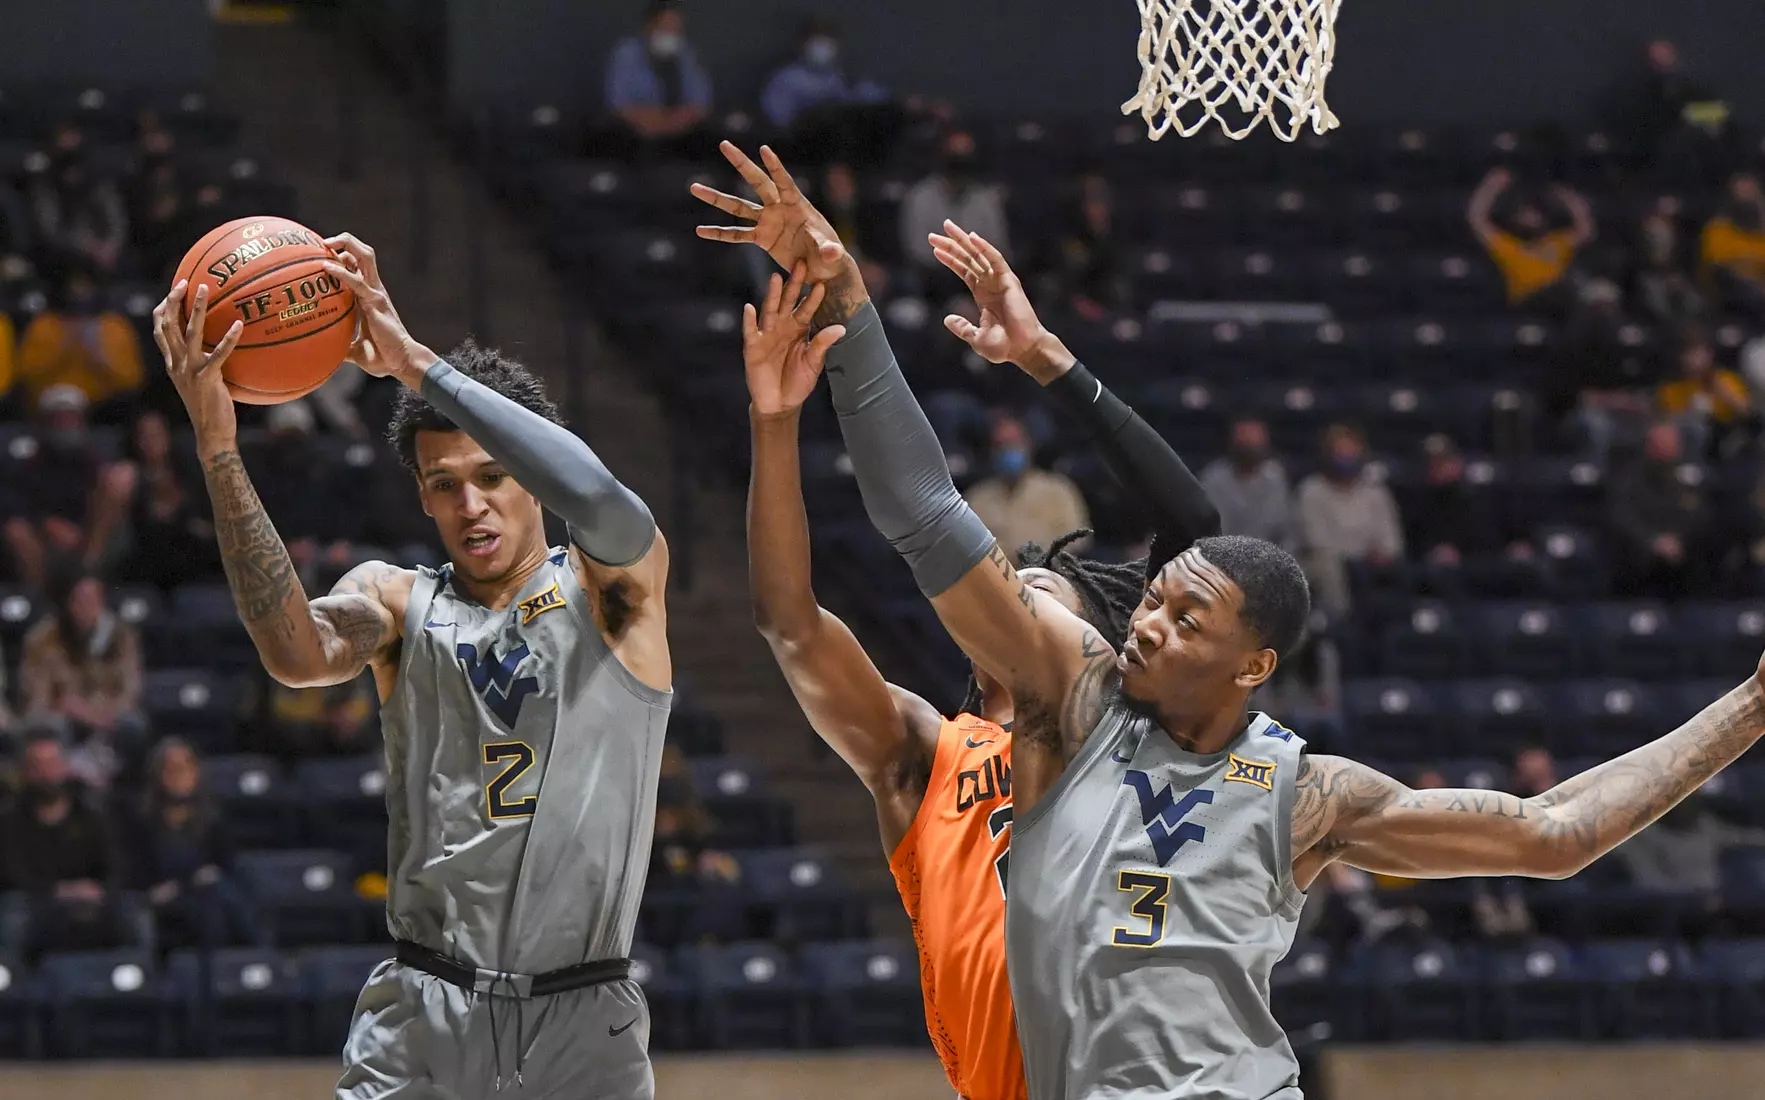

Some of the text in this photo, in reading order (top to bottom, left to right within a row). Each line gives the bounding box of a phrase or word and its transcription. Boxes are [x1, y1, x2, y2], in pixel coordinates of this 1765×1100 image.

[207, 229, 324, 288] SPALDING
[235, 274, 342, 322] TF-1000
[280, 300, 320, 321] LEGACY
[483, 740, 538, 819] 2
[1111, 868, 1172, 948] 3
